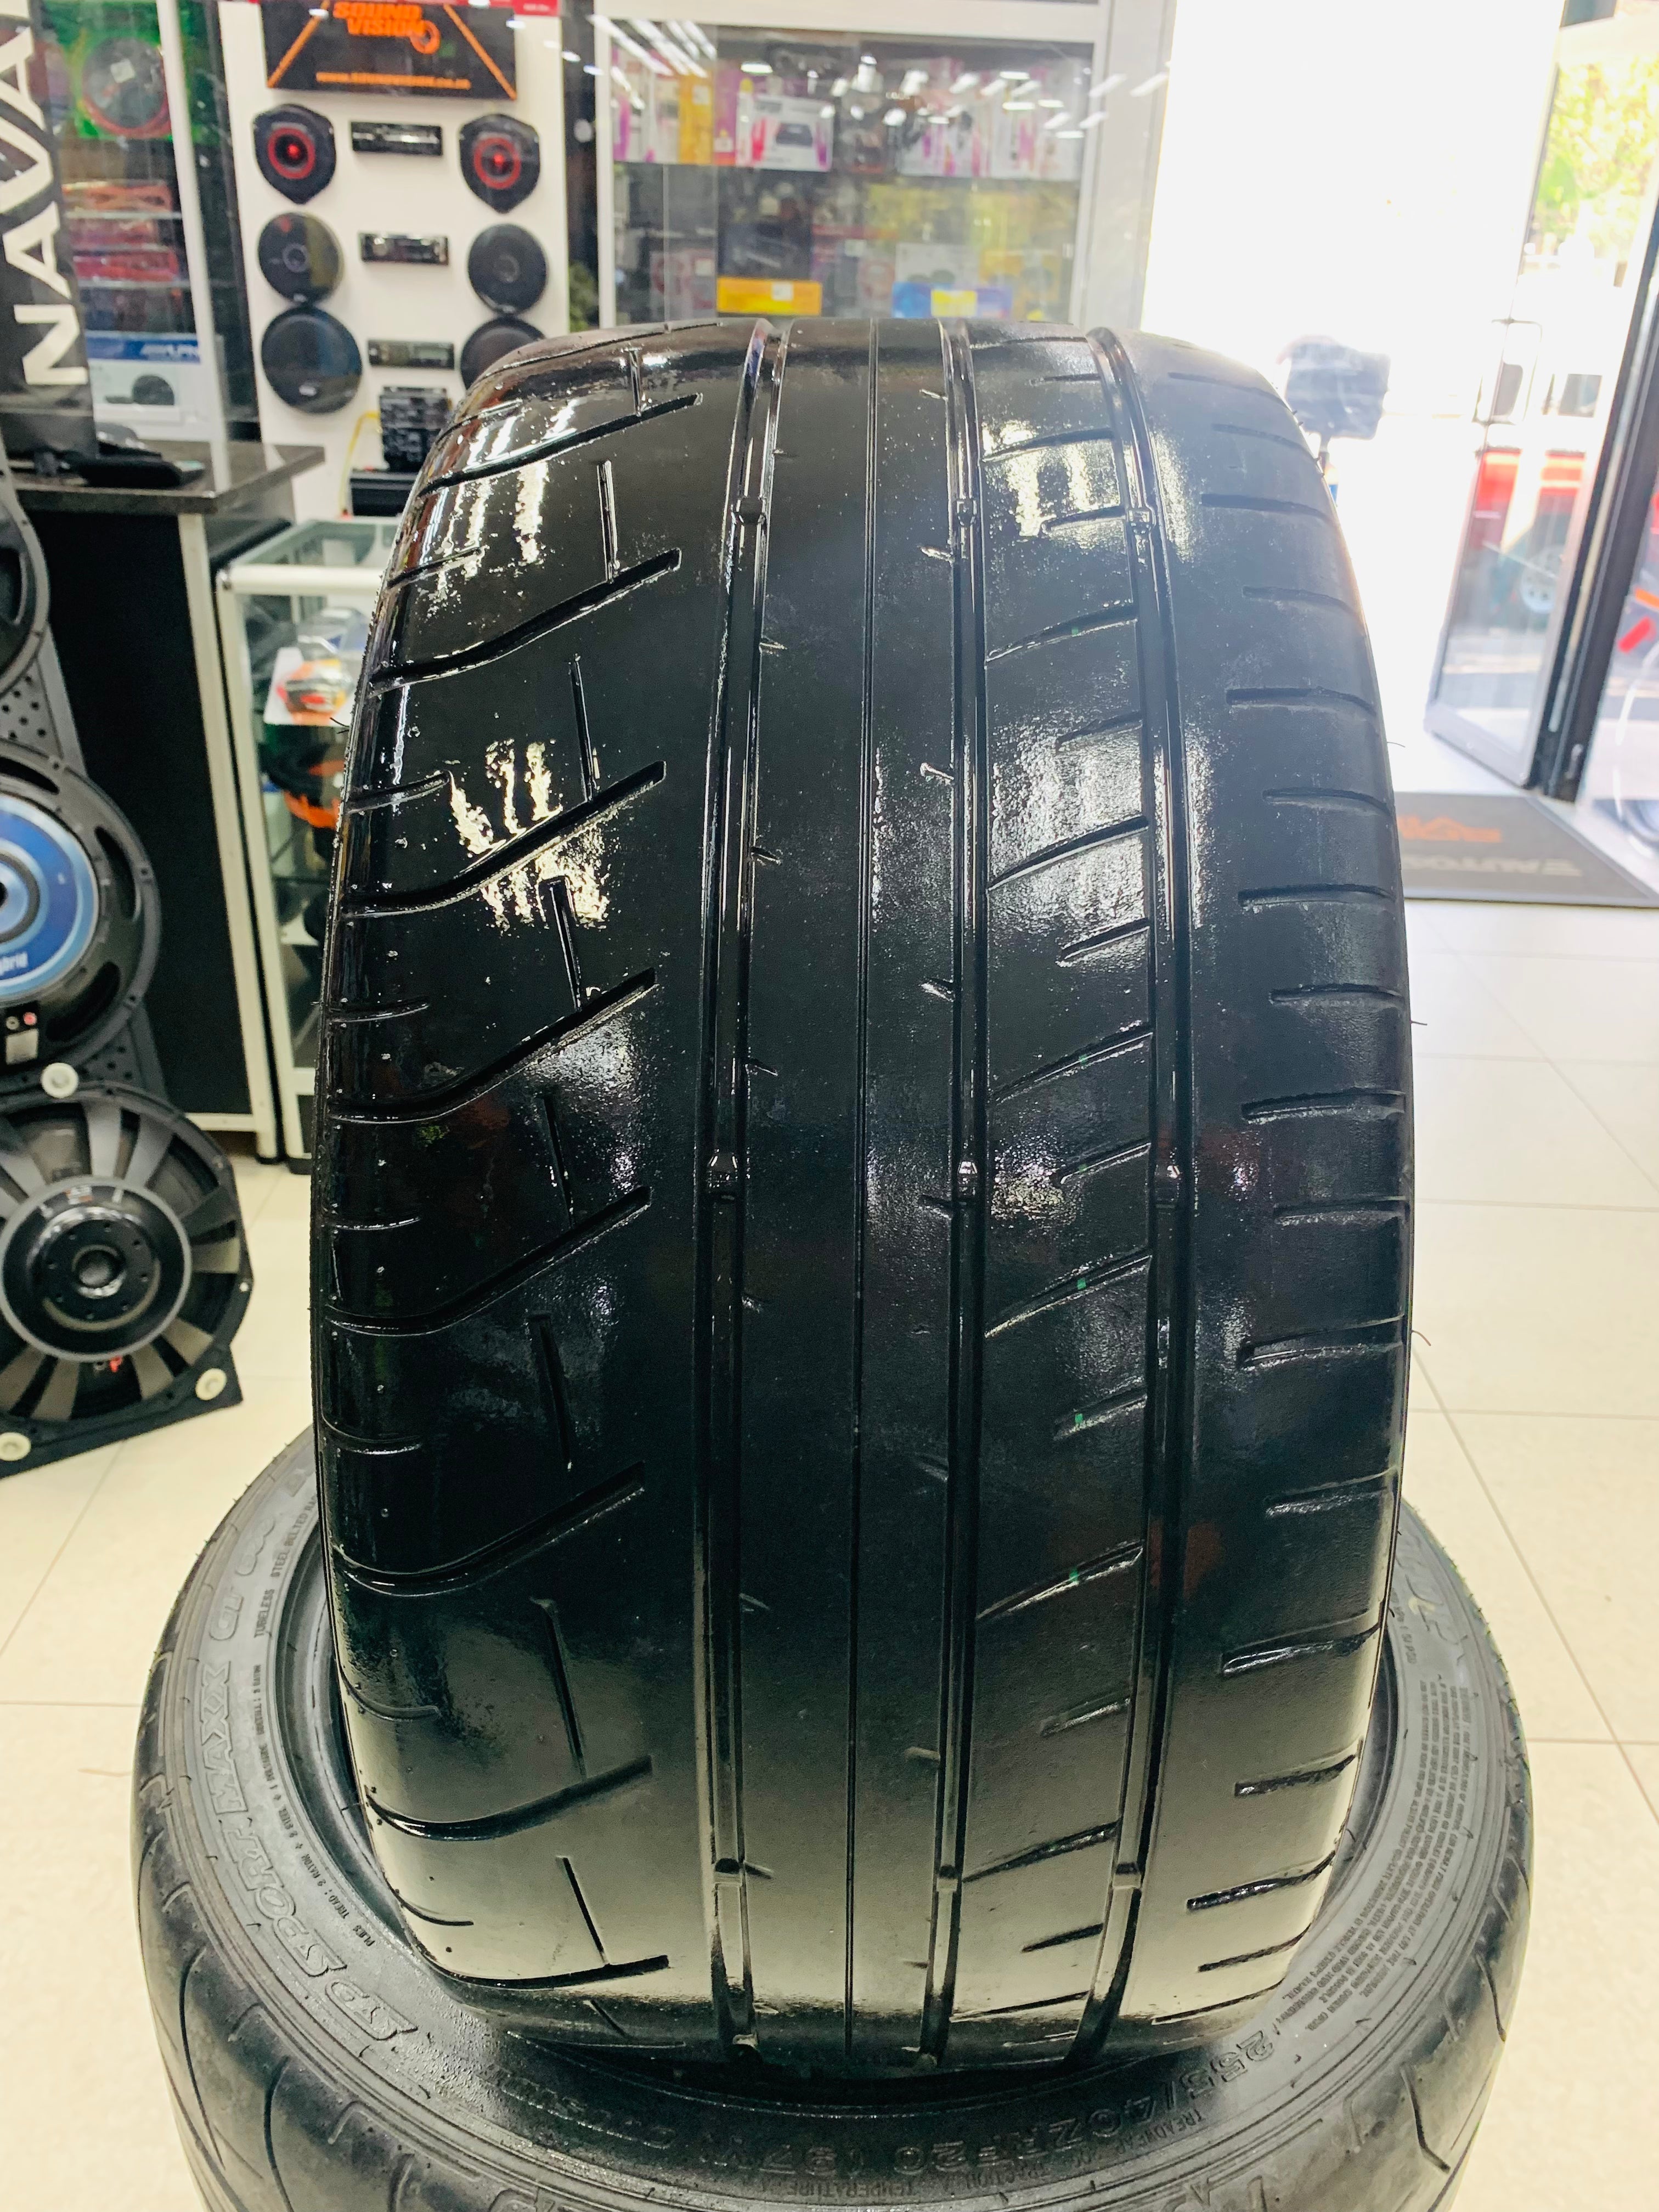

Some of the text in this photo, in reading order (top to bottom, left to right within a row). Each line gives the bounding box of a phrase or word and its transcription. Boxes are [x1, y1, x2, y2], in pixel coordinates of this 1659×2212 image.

[333, 2, 422, 19] SOUND
[347, 18, 426, 37] VISION
[253, 1587, 275, 1639] TUBELESS
[200, 1661, 248, 1815] MAXX
[225, 1826, 348, 1977] SPORT
[325, 1980, 419, 2041] SP
